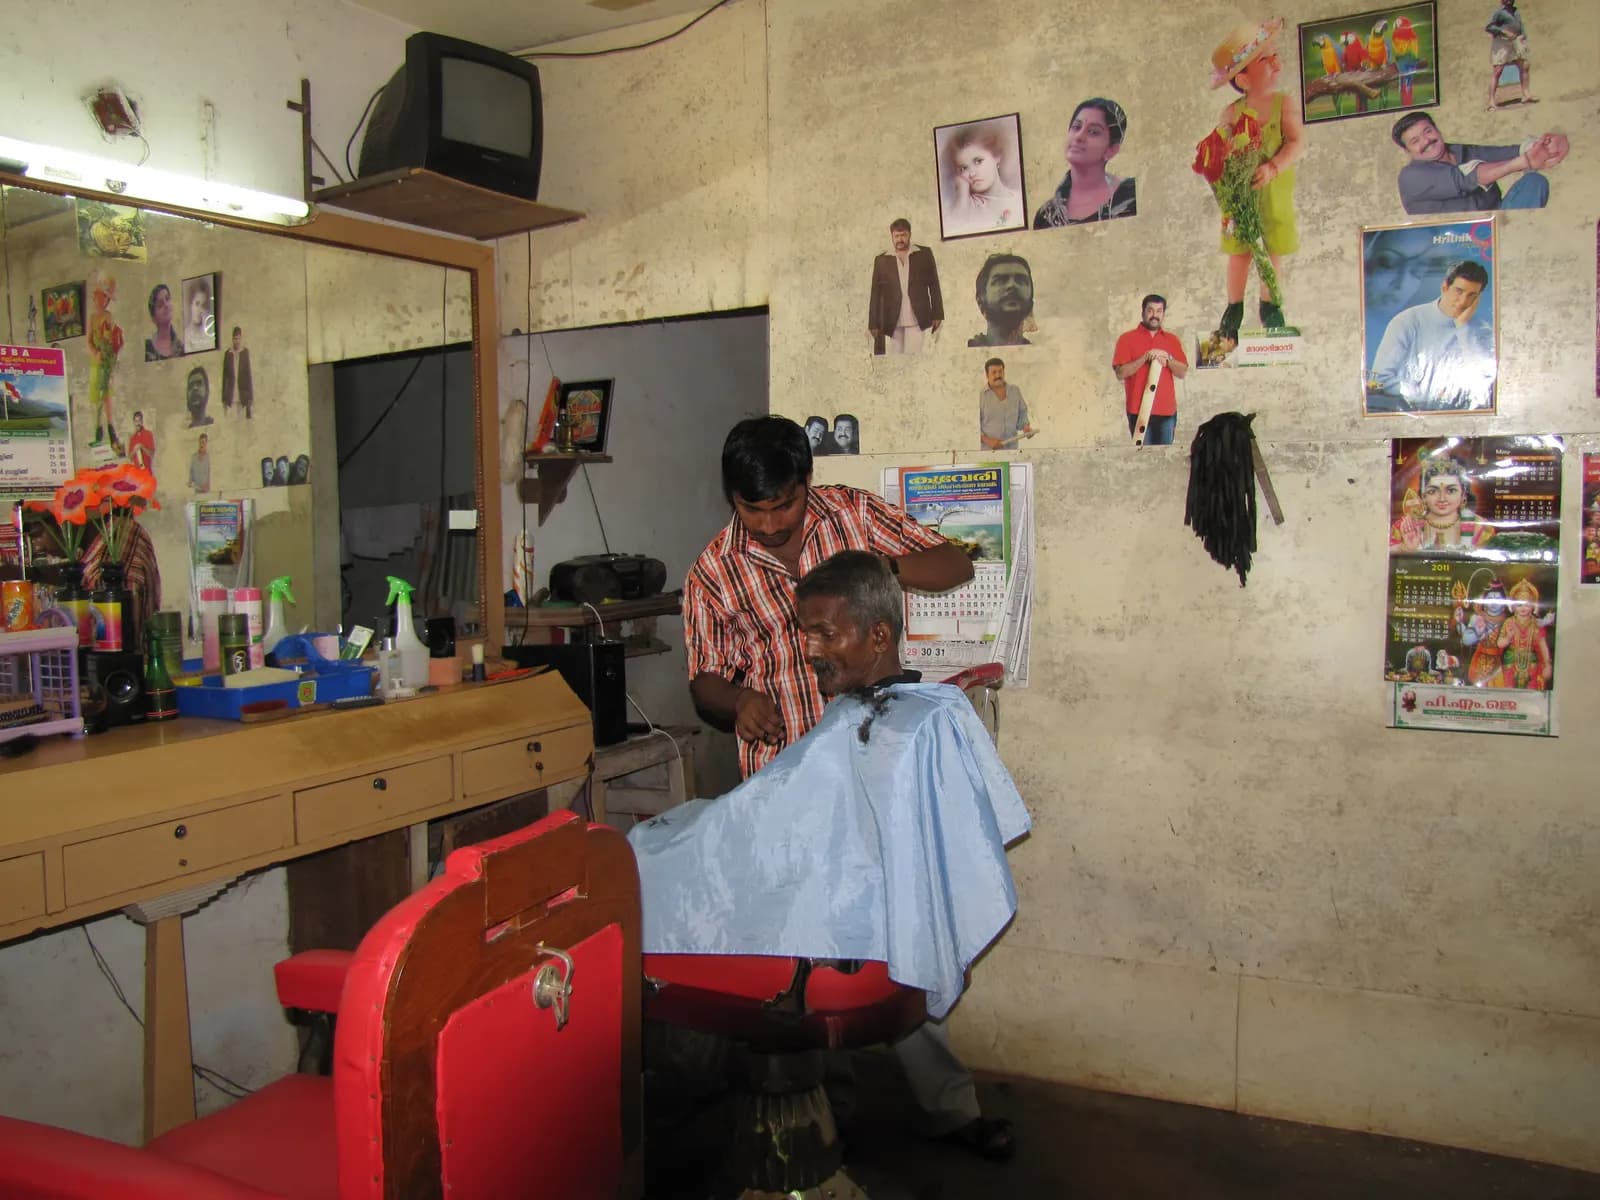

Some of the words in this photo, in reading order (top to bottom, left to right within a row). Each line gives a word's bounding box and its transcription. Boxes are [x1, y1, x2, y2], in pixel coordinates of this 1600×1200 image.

[906, 648, 917, 656] 29
[921, 648, 932, 656] 30
[936, 648, 944, 656] 31
